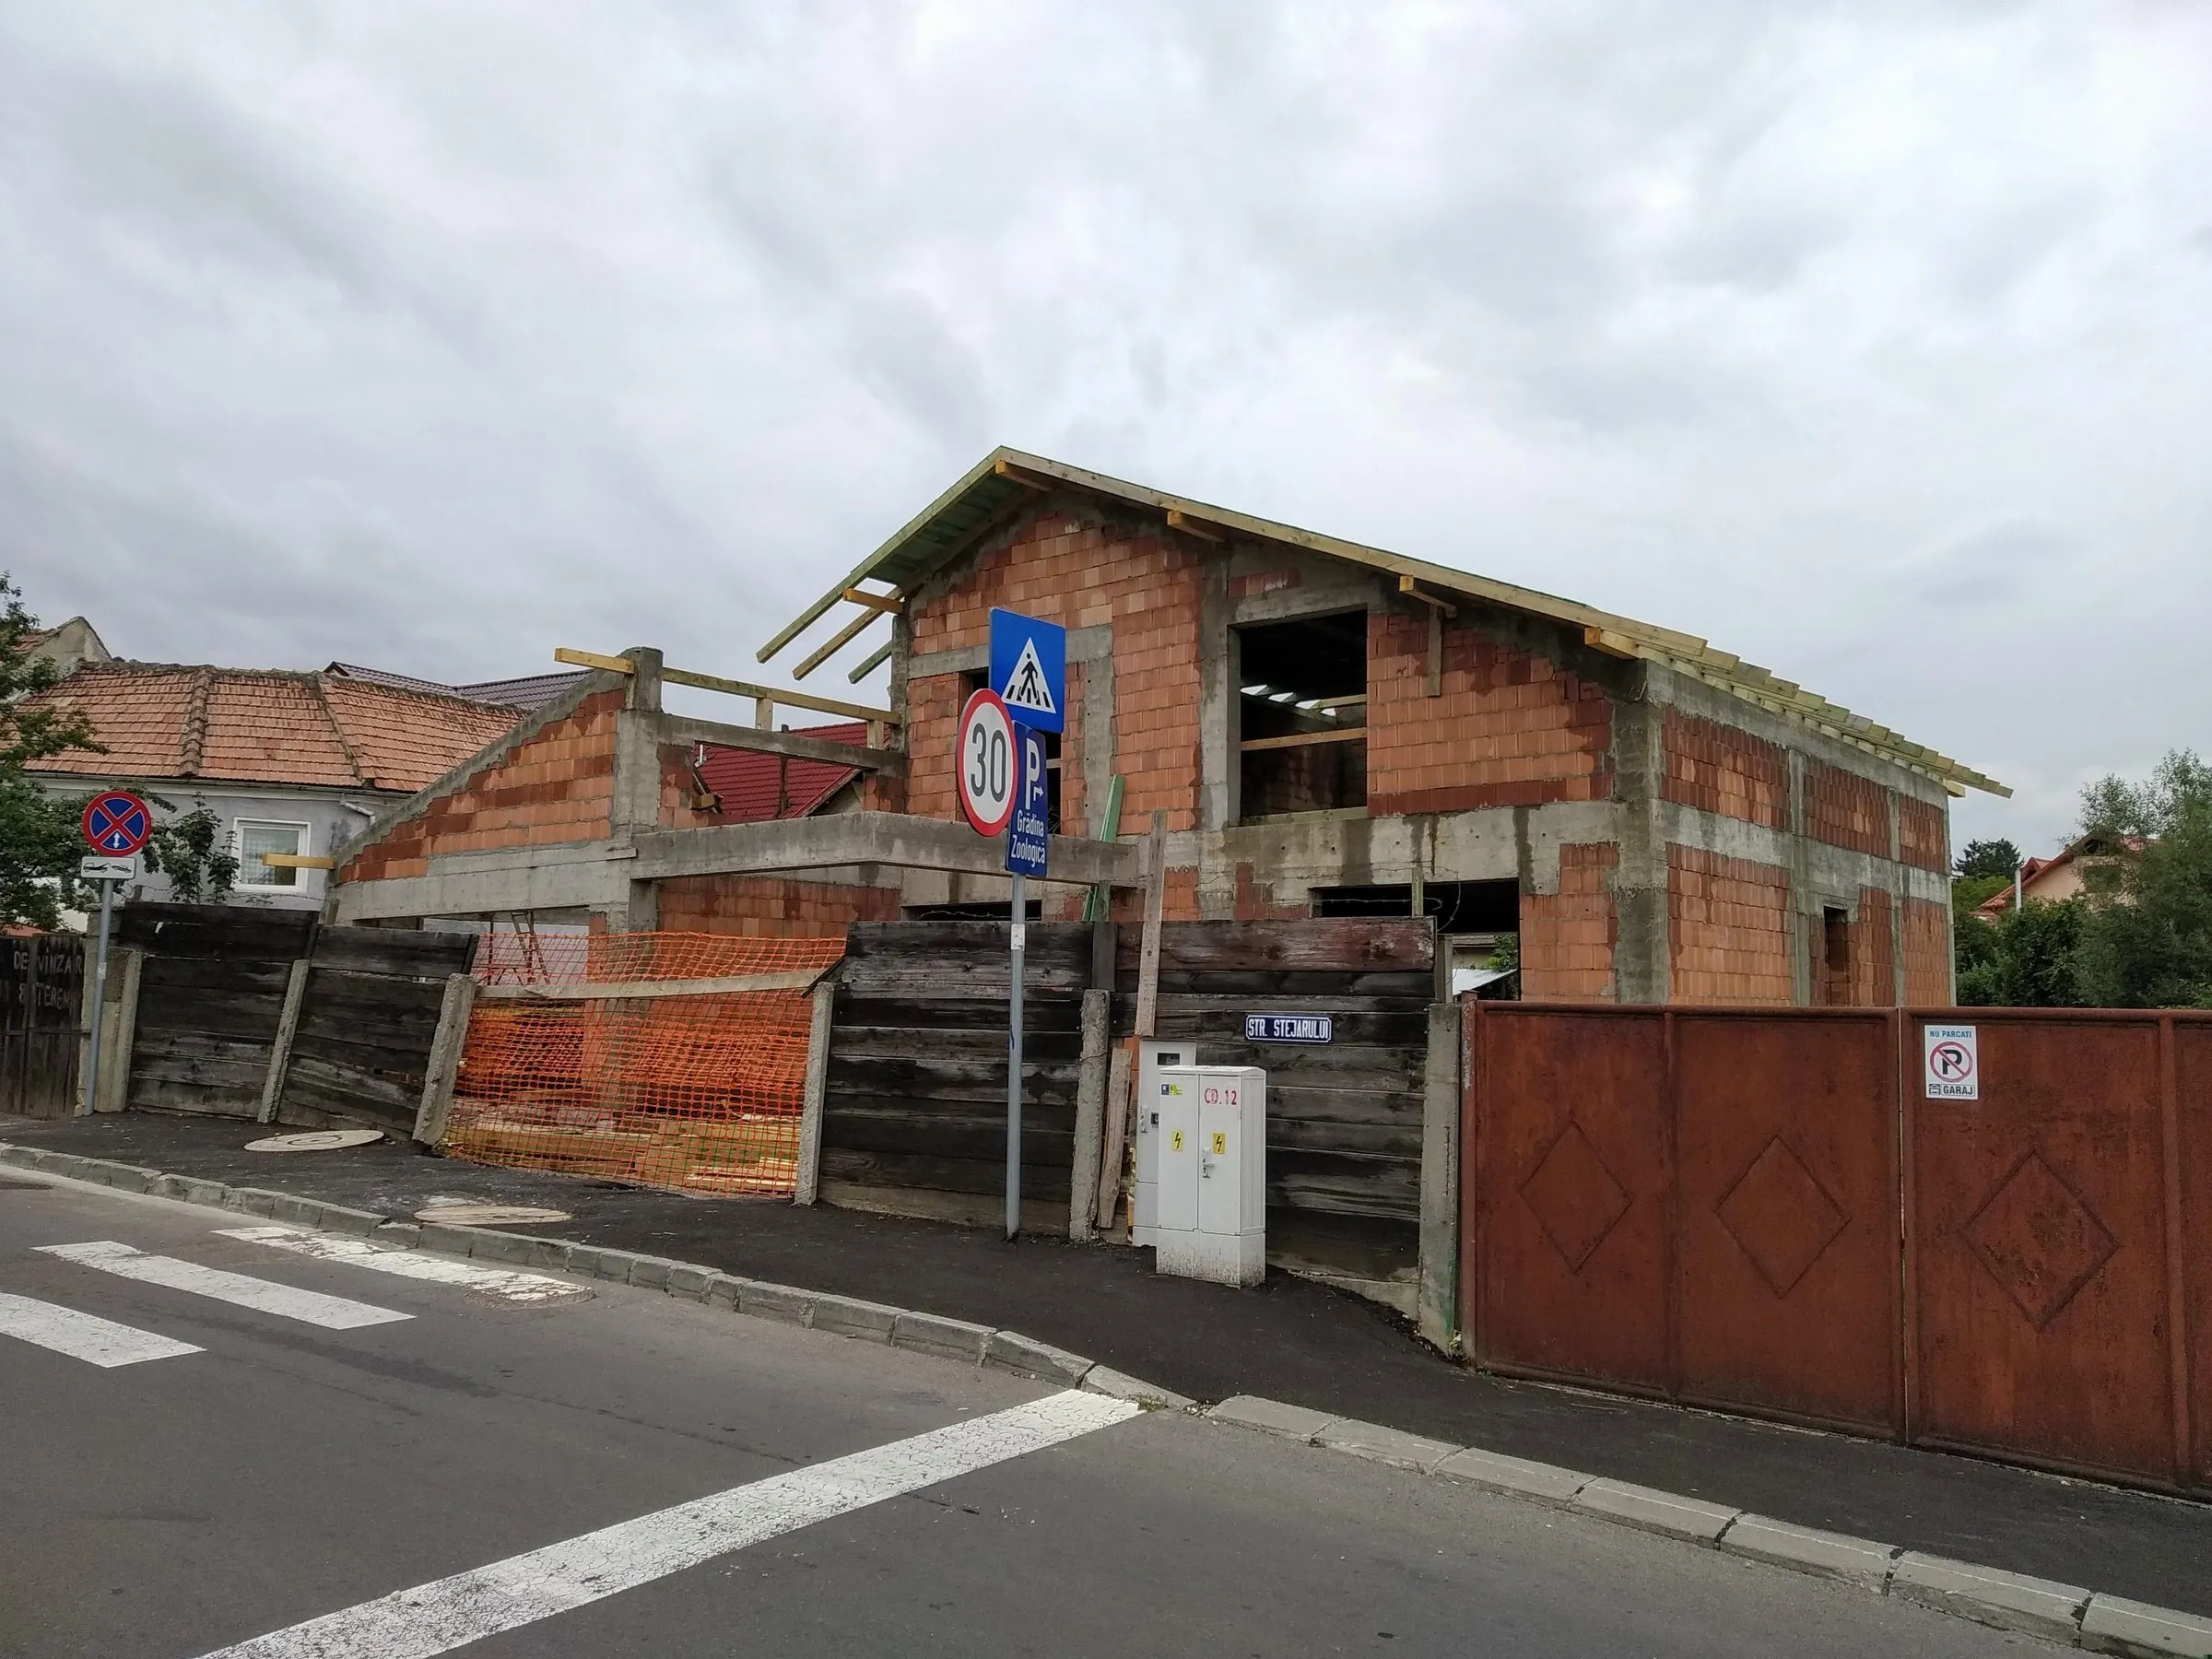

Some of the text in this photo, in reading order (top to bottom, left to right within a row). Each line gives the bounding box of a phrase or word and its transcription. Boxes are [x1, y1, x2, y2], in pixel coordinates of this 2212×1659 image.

[971, 723, 1006, 803] 30
[1025, 737, 1041, 810] P
[1017, 809, 1044, 838] Grădina
[1010, 834, 1046, 868] Zoologică
[1248, 1018, 1329, 1039] STR. STEJARULUI
[1943, 1085, 1973, 1095] GARAJ
